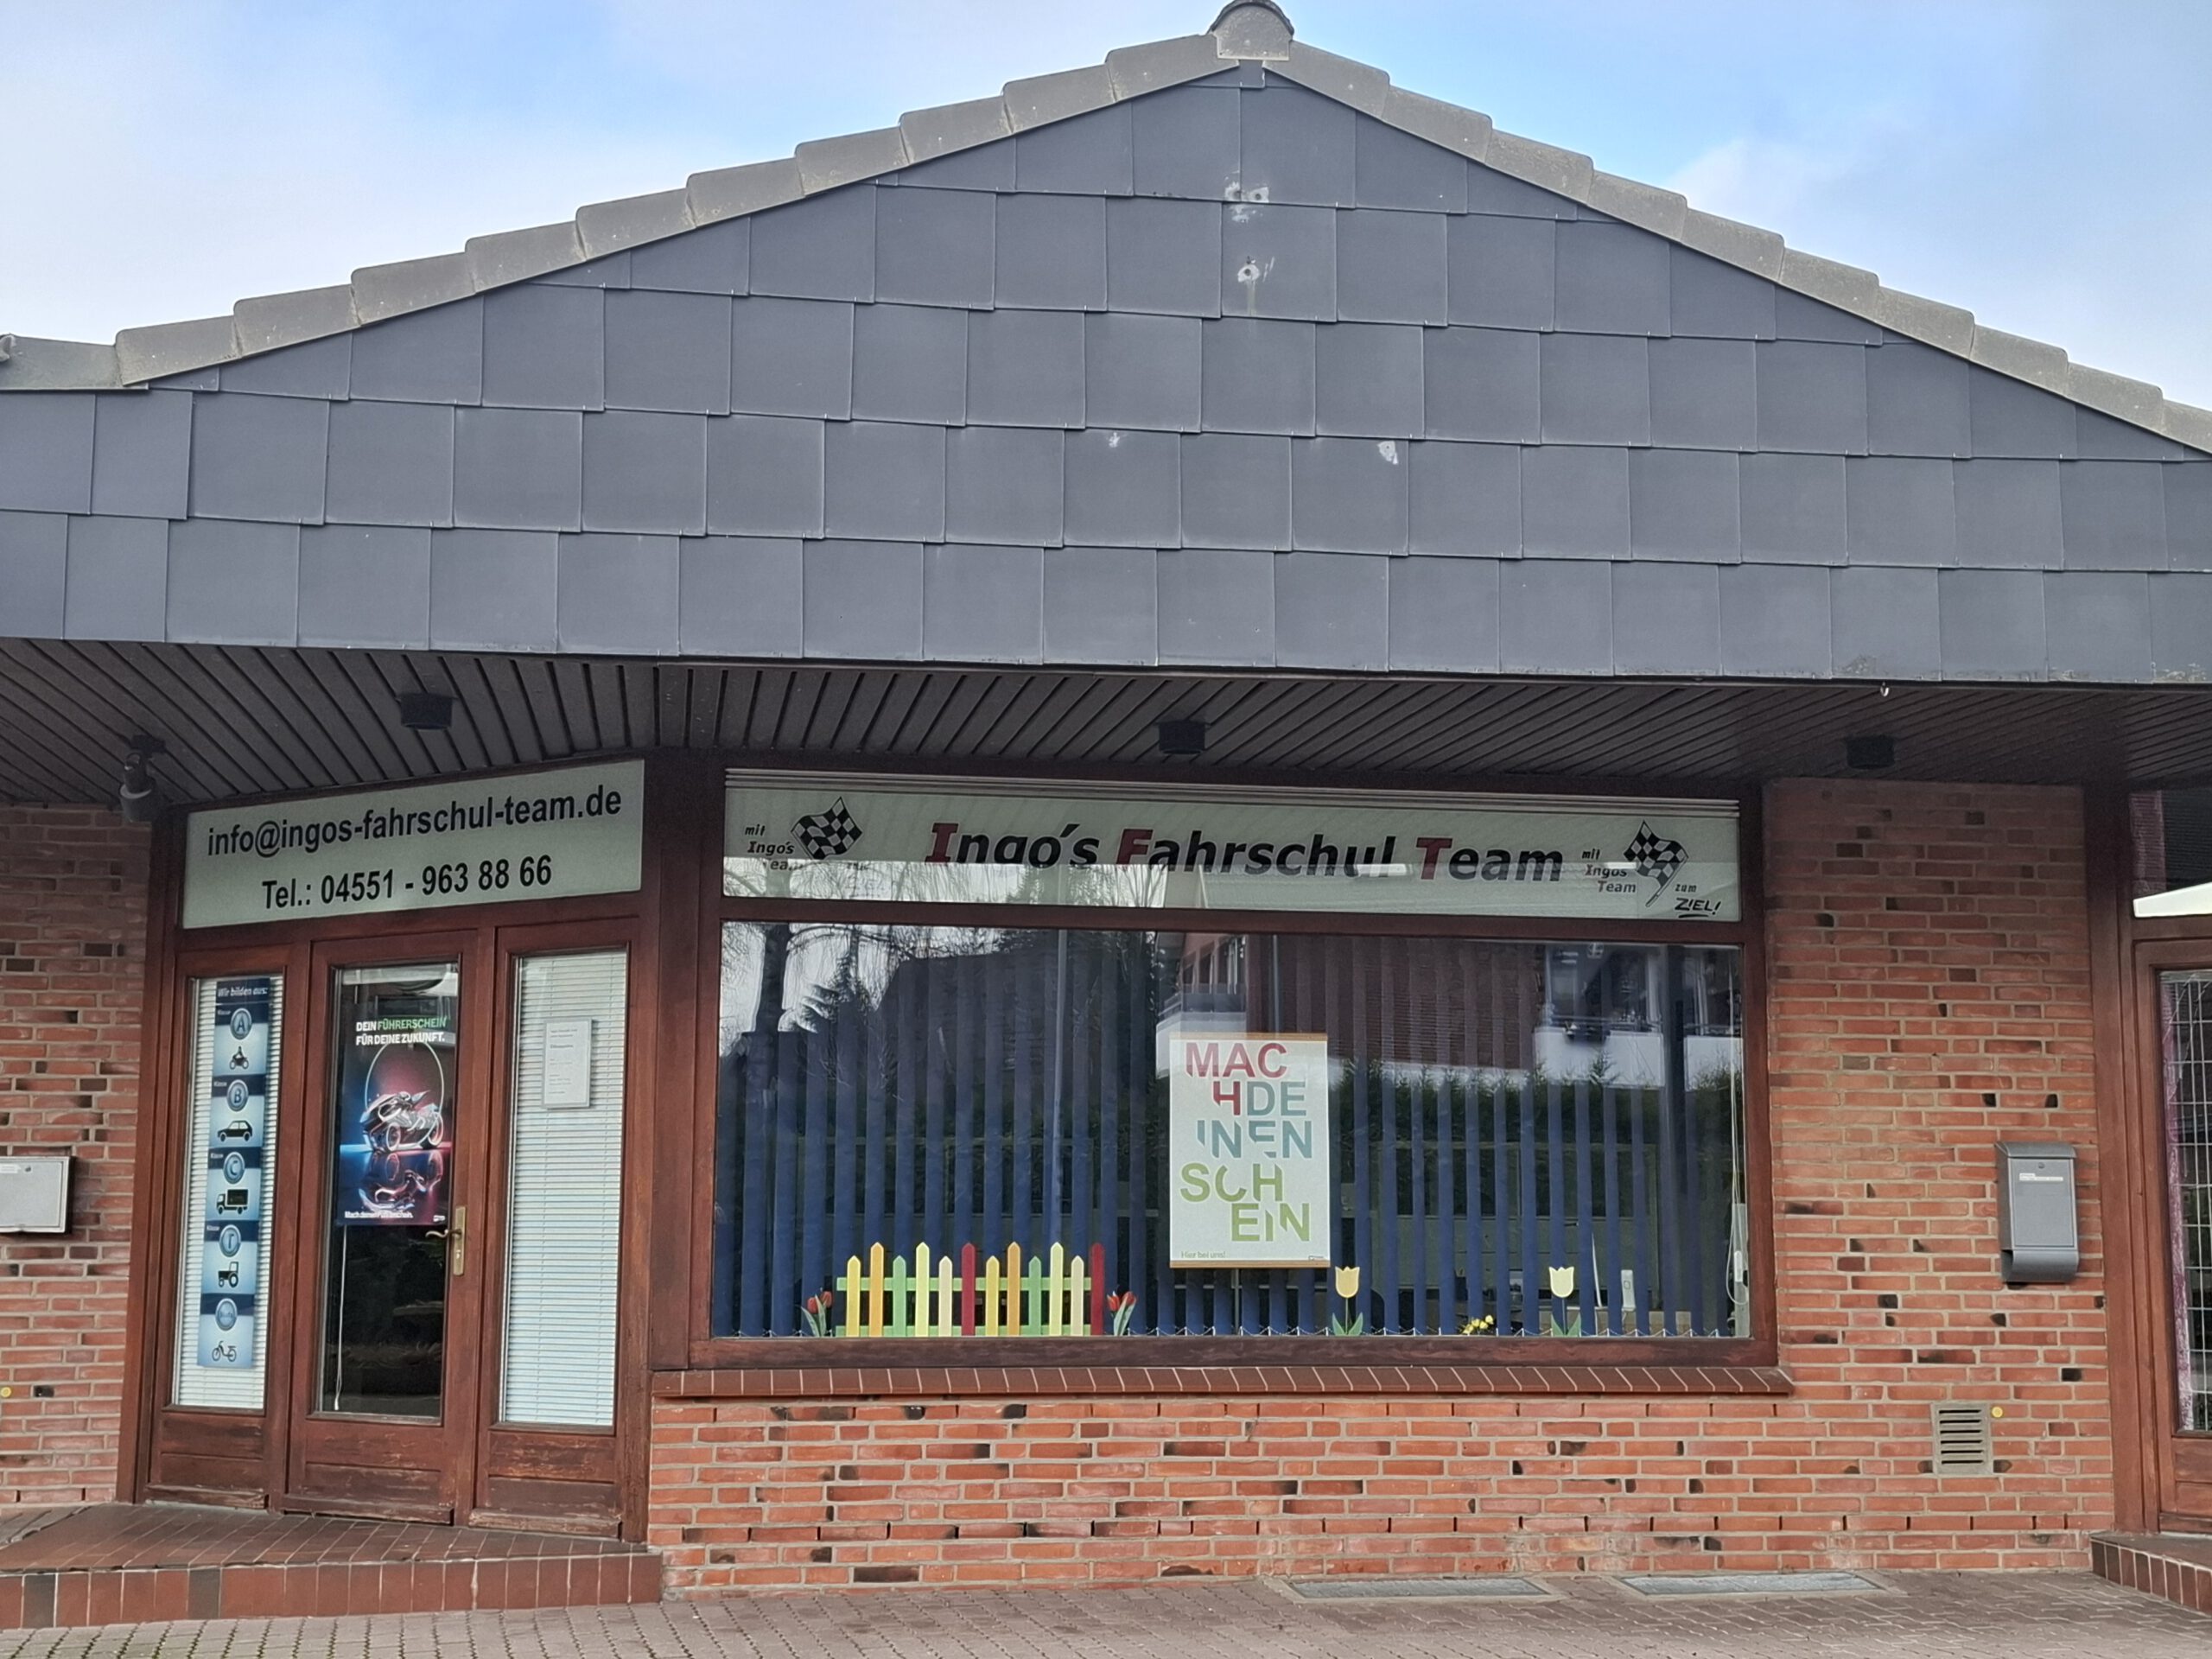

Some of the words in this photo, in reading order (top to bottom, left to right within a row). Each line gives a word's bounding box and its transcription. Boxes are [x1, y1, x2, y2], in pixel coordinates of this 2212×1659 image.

[207, 785, 621, 857] info@ingos-fahrschul-team.de
[745, 824, 766, 836] mit
[1115, 829, 1396, 877] Fahrschul
[1415, 837, 1563, 881] Team
[1581, 849, 1600, 861] mit
[262, 878, 311, 909] Tel.:
[321, 868, 395, 904] 04551
[404, 881, 414, 890] -
[422, 864, 468, 895] 963
[479, 859, 510, 891] 88
[519, 855, 552, 886] 66
[1598, 880, 1636, 893] Team
[1675, 883, 1697, 893] zum
[1675, 898, 1722, 915] ZIEL!
[236, 1015, 245, 1032] A
[356, 1021, 377, 1032] DEIN
[378, 1016, 447, 1029] FÜHRERSCHEIN
[356, 1033, 373, 1046] FÜR
[374, 1034, 401, 1045] DEINE
[401, 1032, 445, 1043] ZUKUNFT.
[1185, 1042, 1287, 1077] MAC
[234, 1089, 242, 1103] B
[1197, 1120, 1313, 1159] INEN
[1180, 1162, 1283, 1202] SCH
[1231, 1203, 1310, 1242] EIN
[1181, 1250, 1196, 1259] Hier
[1198, 1250, 1209, 1259] bei
